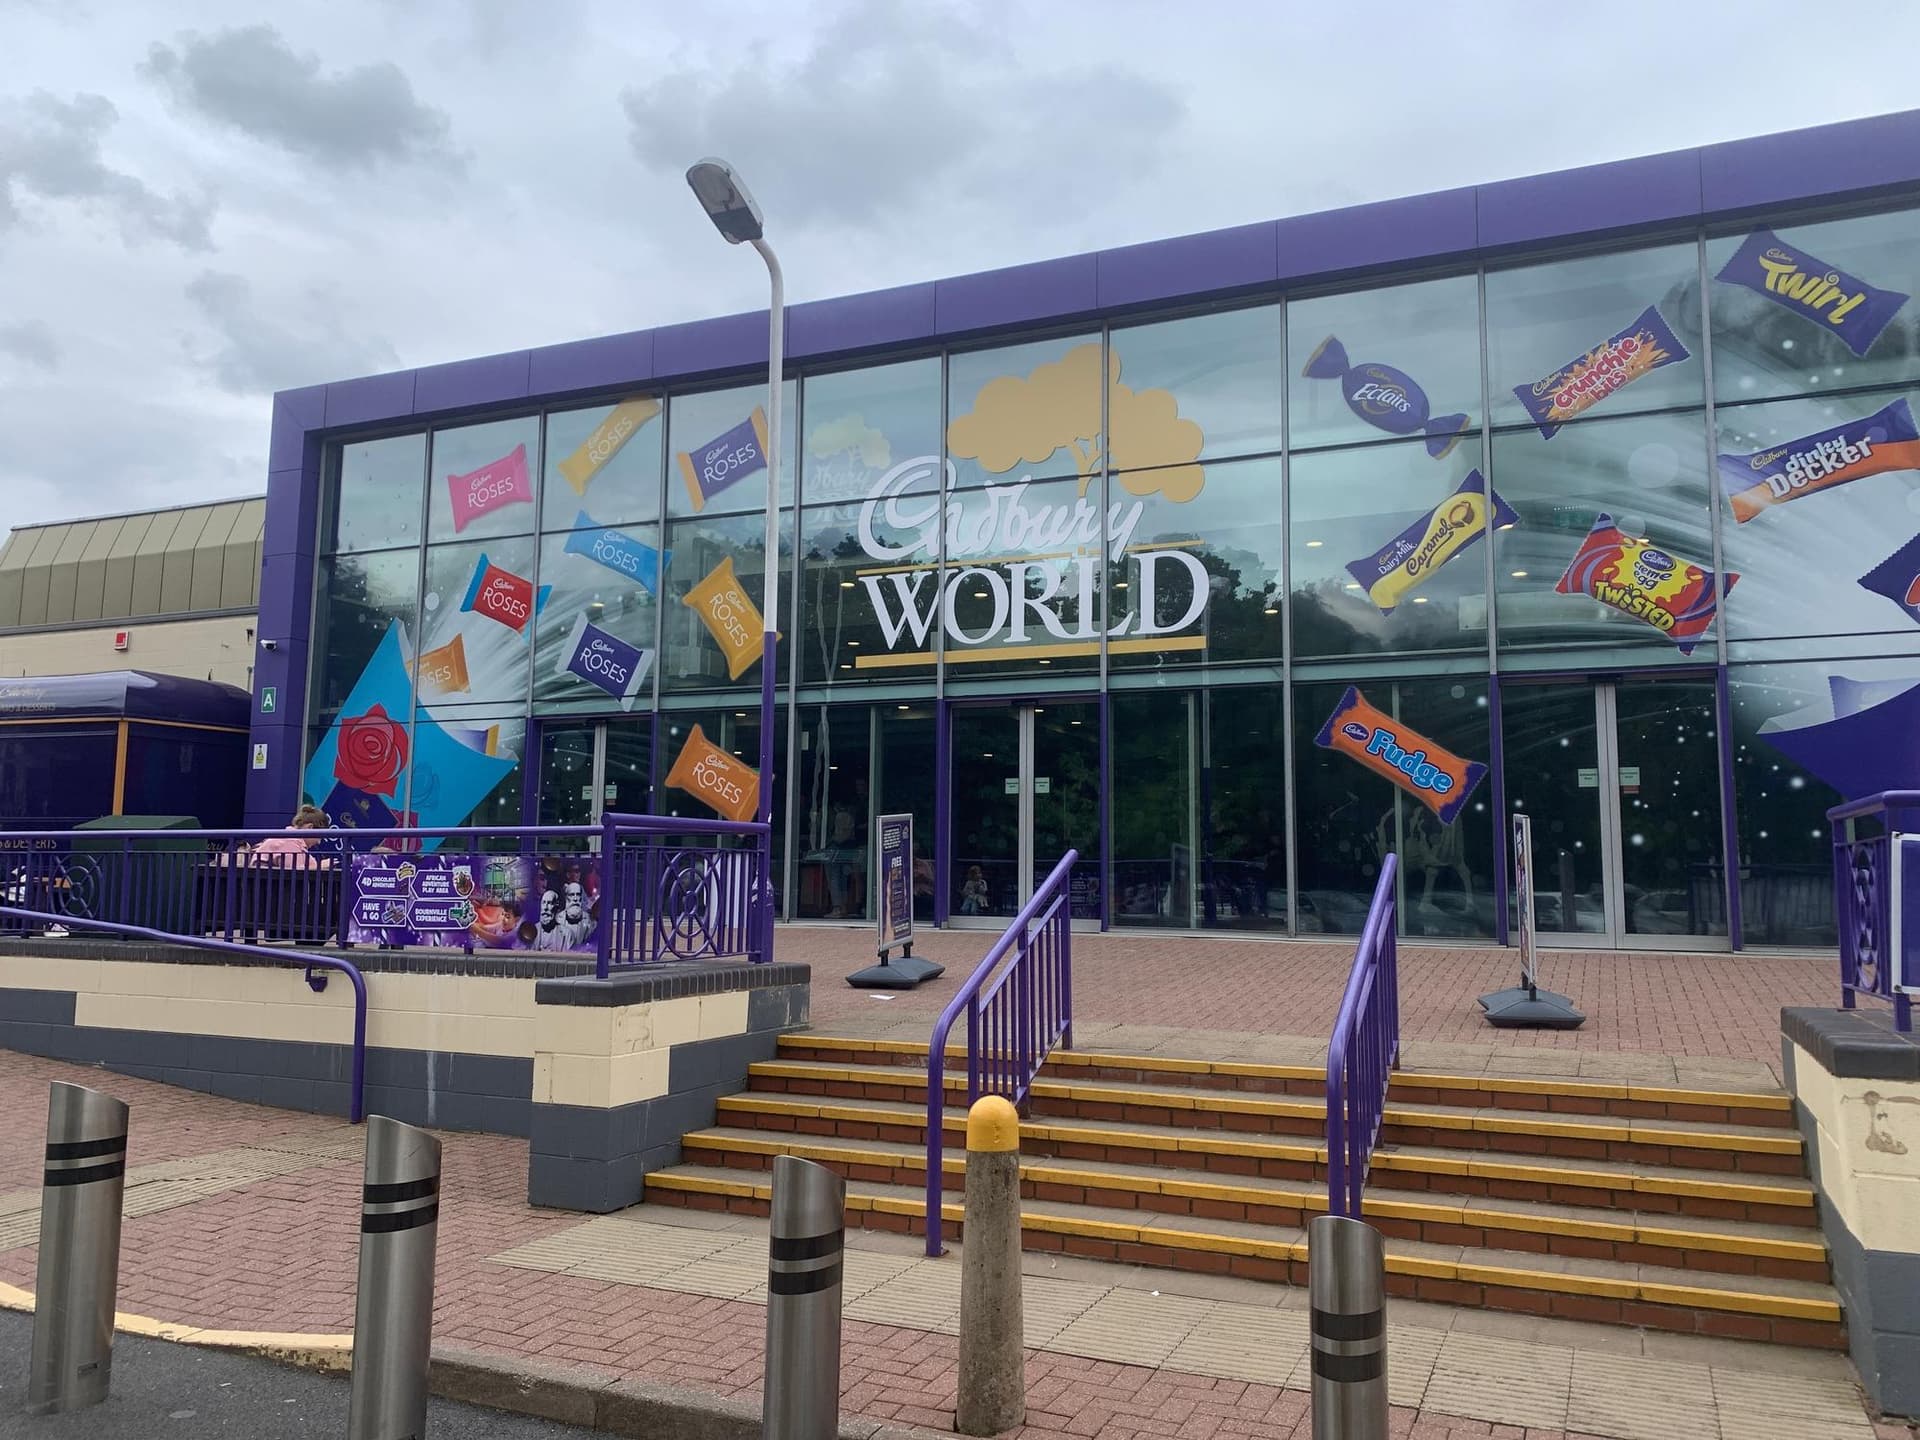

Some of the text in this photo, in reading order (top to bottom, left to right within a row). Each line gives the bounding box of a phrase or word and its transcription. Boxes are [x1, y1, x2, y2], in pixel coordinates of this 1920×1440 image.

[1759, 255, 1866, 324] Twirl
[1352, 383, 1411, 412] Eclairs
[589, 416, 633, 465] ROSES
[1751, 448, 1788, 470] Cadbury
[1785, 435, 1847, 473] dinky
[703, 442, 756, 483] ROSES
[1765, 436, 1871, 498] Decker
[468, 477, 514, 508] ROSES
[858, 455, 1144, 563] Cadbury
[592, 539, 640, 572] ROSES
[1378, 541, 1417, 575] Dairy Milk
[1406, 518, 1454, 576] Caramel
[1634, 561, 1672, 581] creme
[1634, 570, 1659, 590] egg
[483, 587, 528, 618] ROSES
[858, 549, 1211, 650] WORLD
[709, 592, 749, 647] ROSES
[580, 647, 627, 684] ROSES
[263, 693, 273, 707] A
[1366, 728, 1453, 793] Fudge
[692, 762, 743, 804] ROSES
[369, 912, 379, 920] GO
